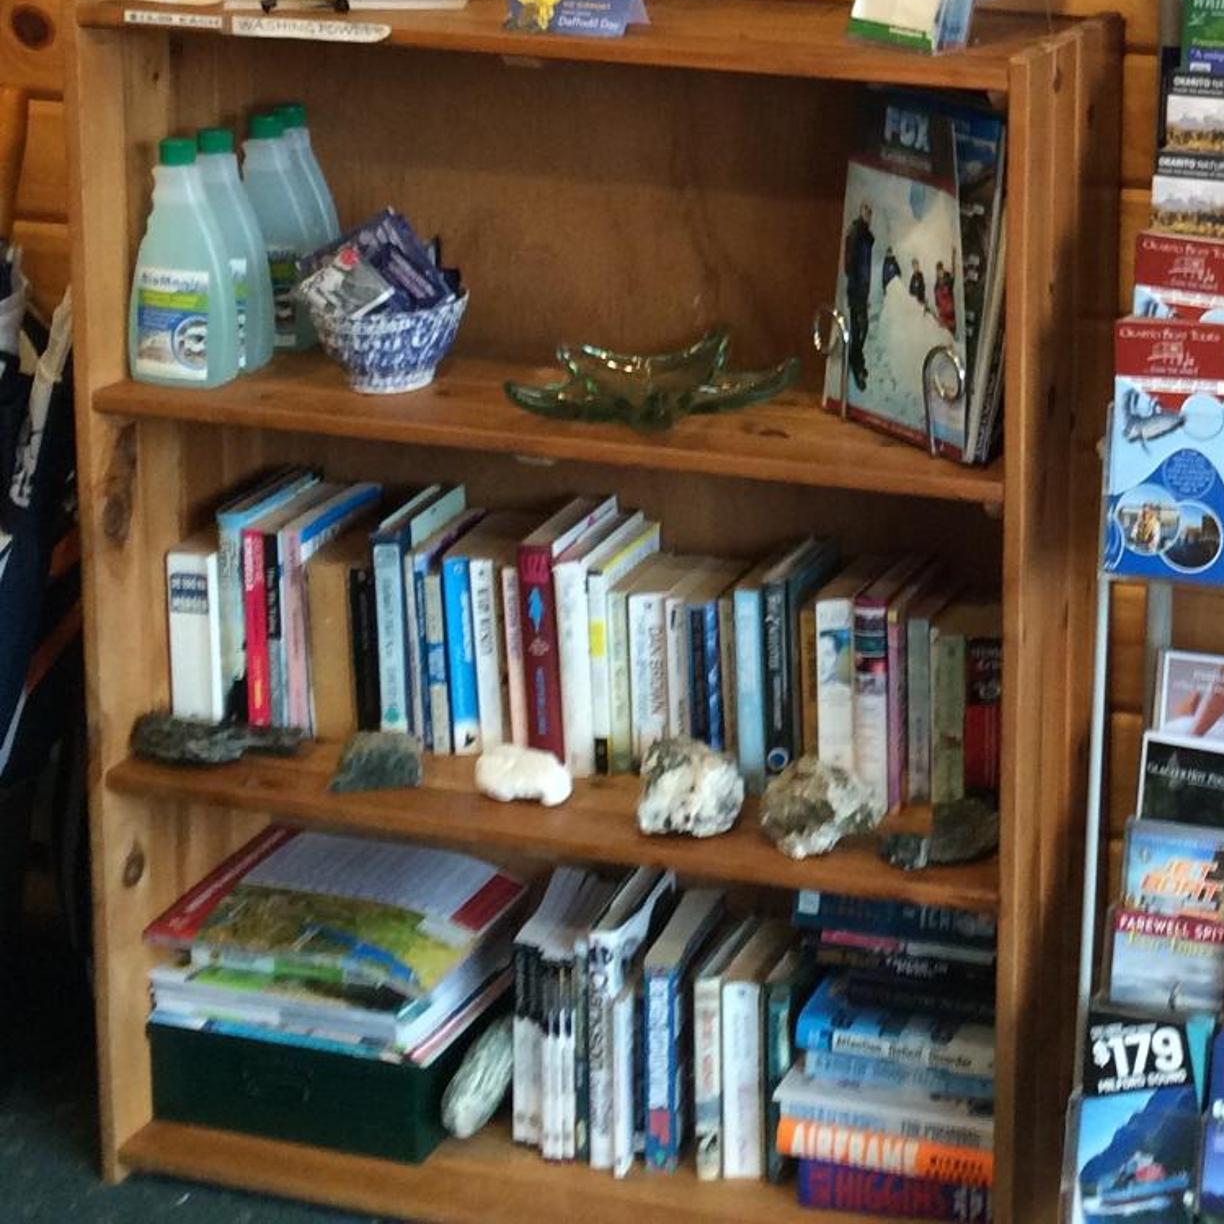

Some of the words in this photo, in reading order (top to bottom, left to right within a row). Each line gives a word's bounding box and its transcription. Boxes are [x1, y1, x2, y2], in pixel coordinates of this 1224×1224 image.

[885, 106, 930, 153] FOX
[1119, 917, 1189, 936] FAREWELL
[1195, 924, 1224, 940] SPIT
[1093, 1027, 1185, 1079] $179
